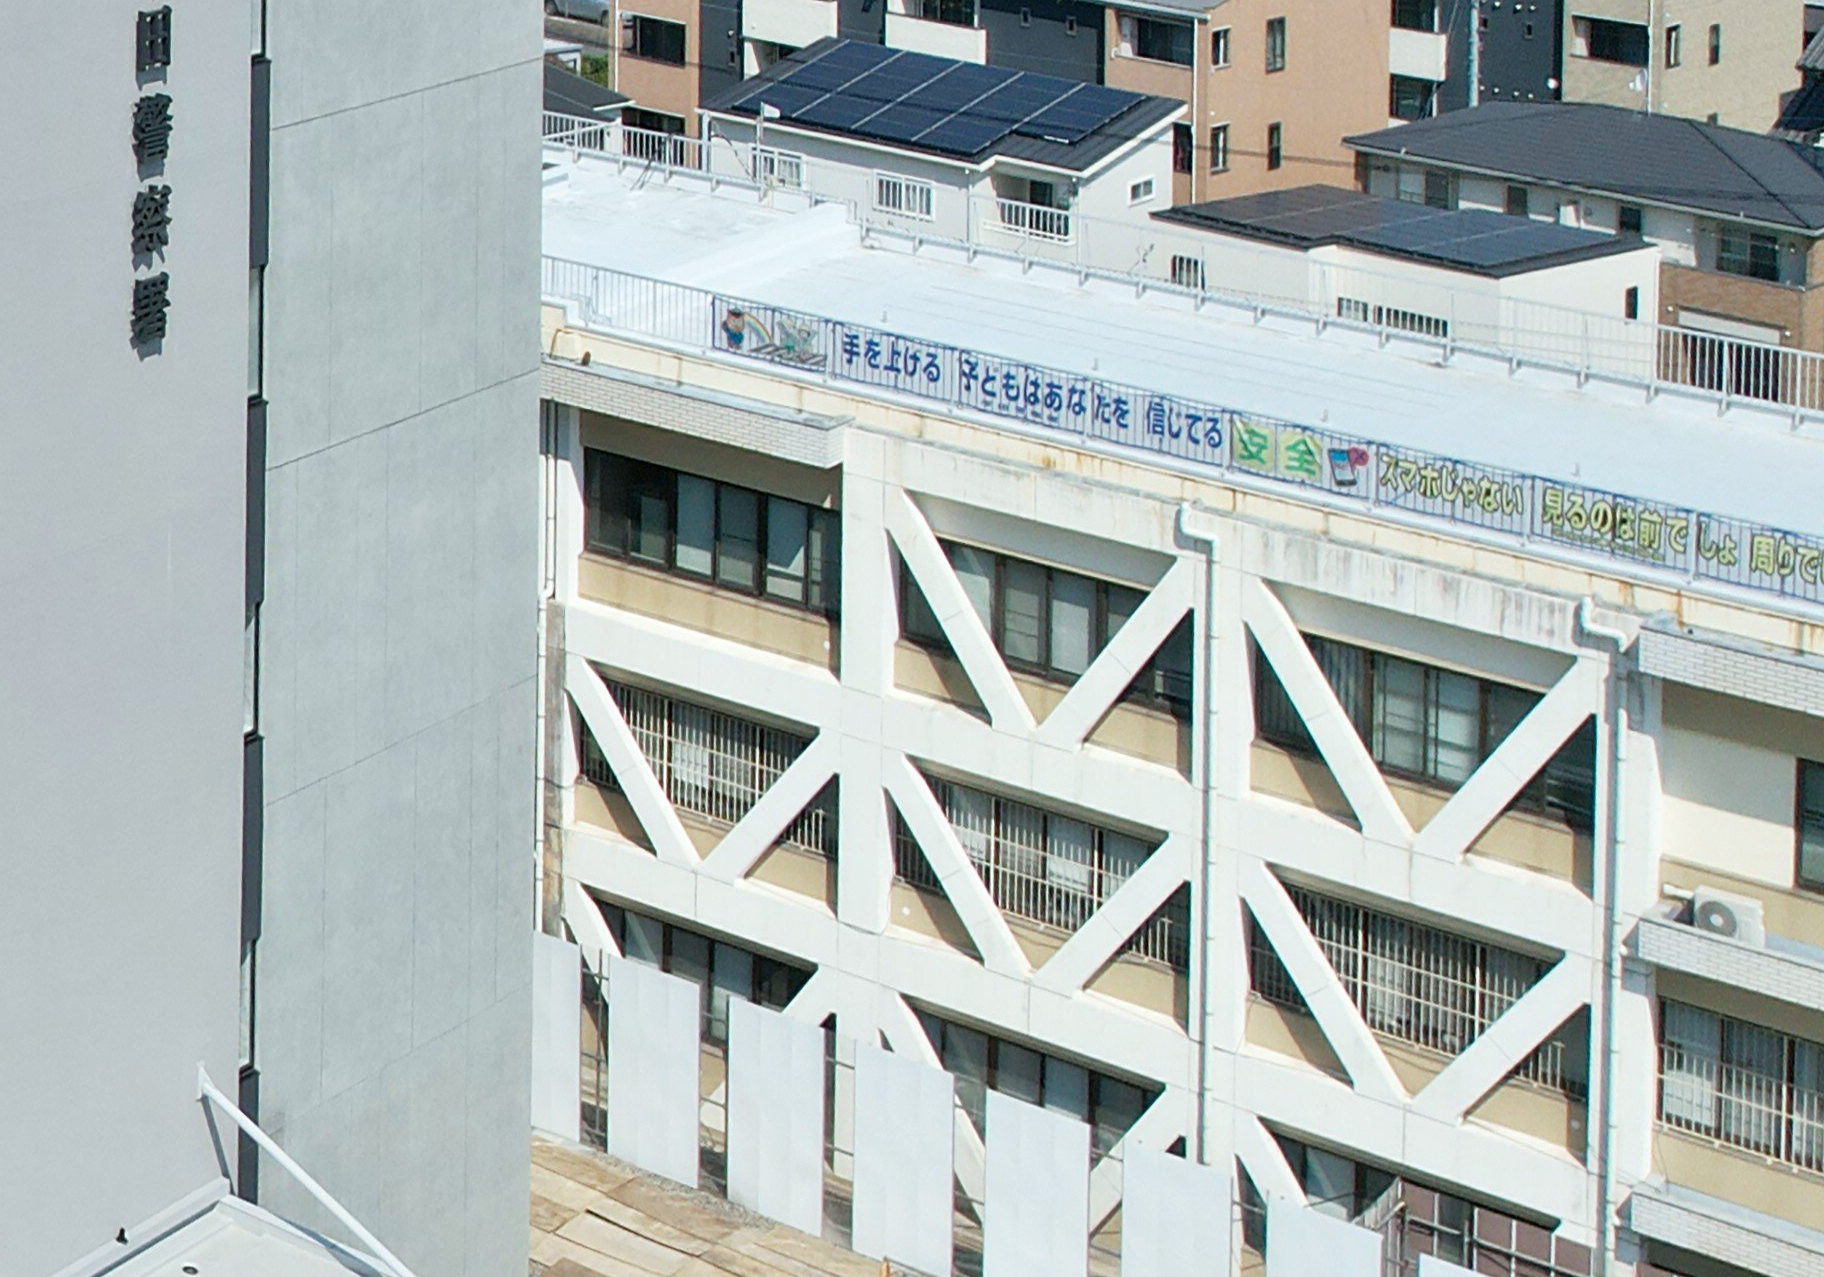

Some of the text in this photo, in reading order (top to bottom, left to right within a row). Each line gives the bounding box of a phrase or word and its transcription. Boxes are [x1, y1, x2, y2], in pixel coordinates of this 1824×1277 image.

[1147, 400, 1223, 448] 信じてる
[1380, 453, 1524, 516] スマホじゃない
[1749, 534, 1824, 586] 周りで
